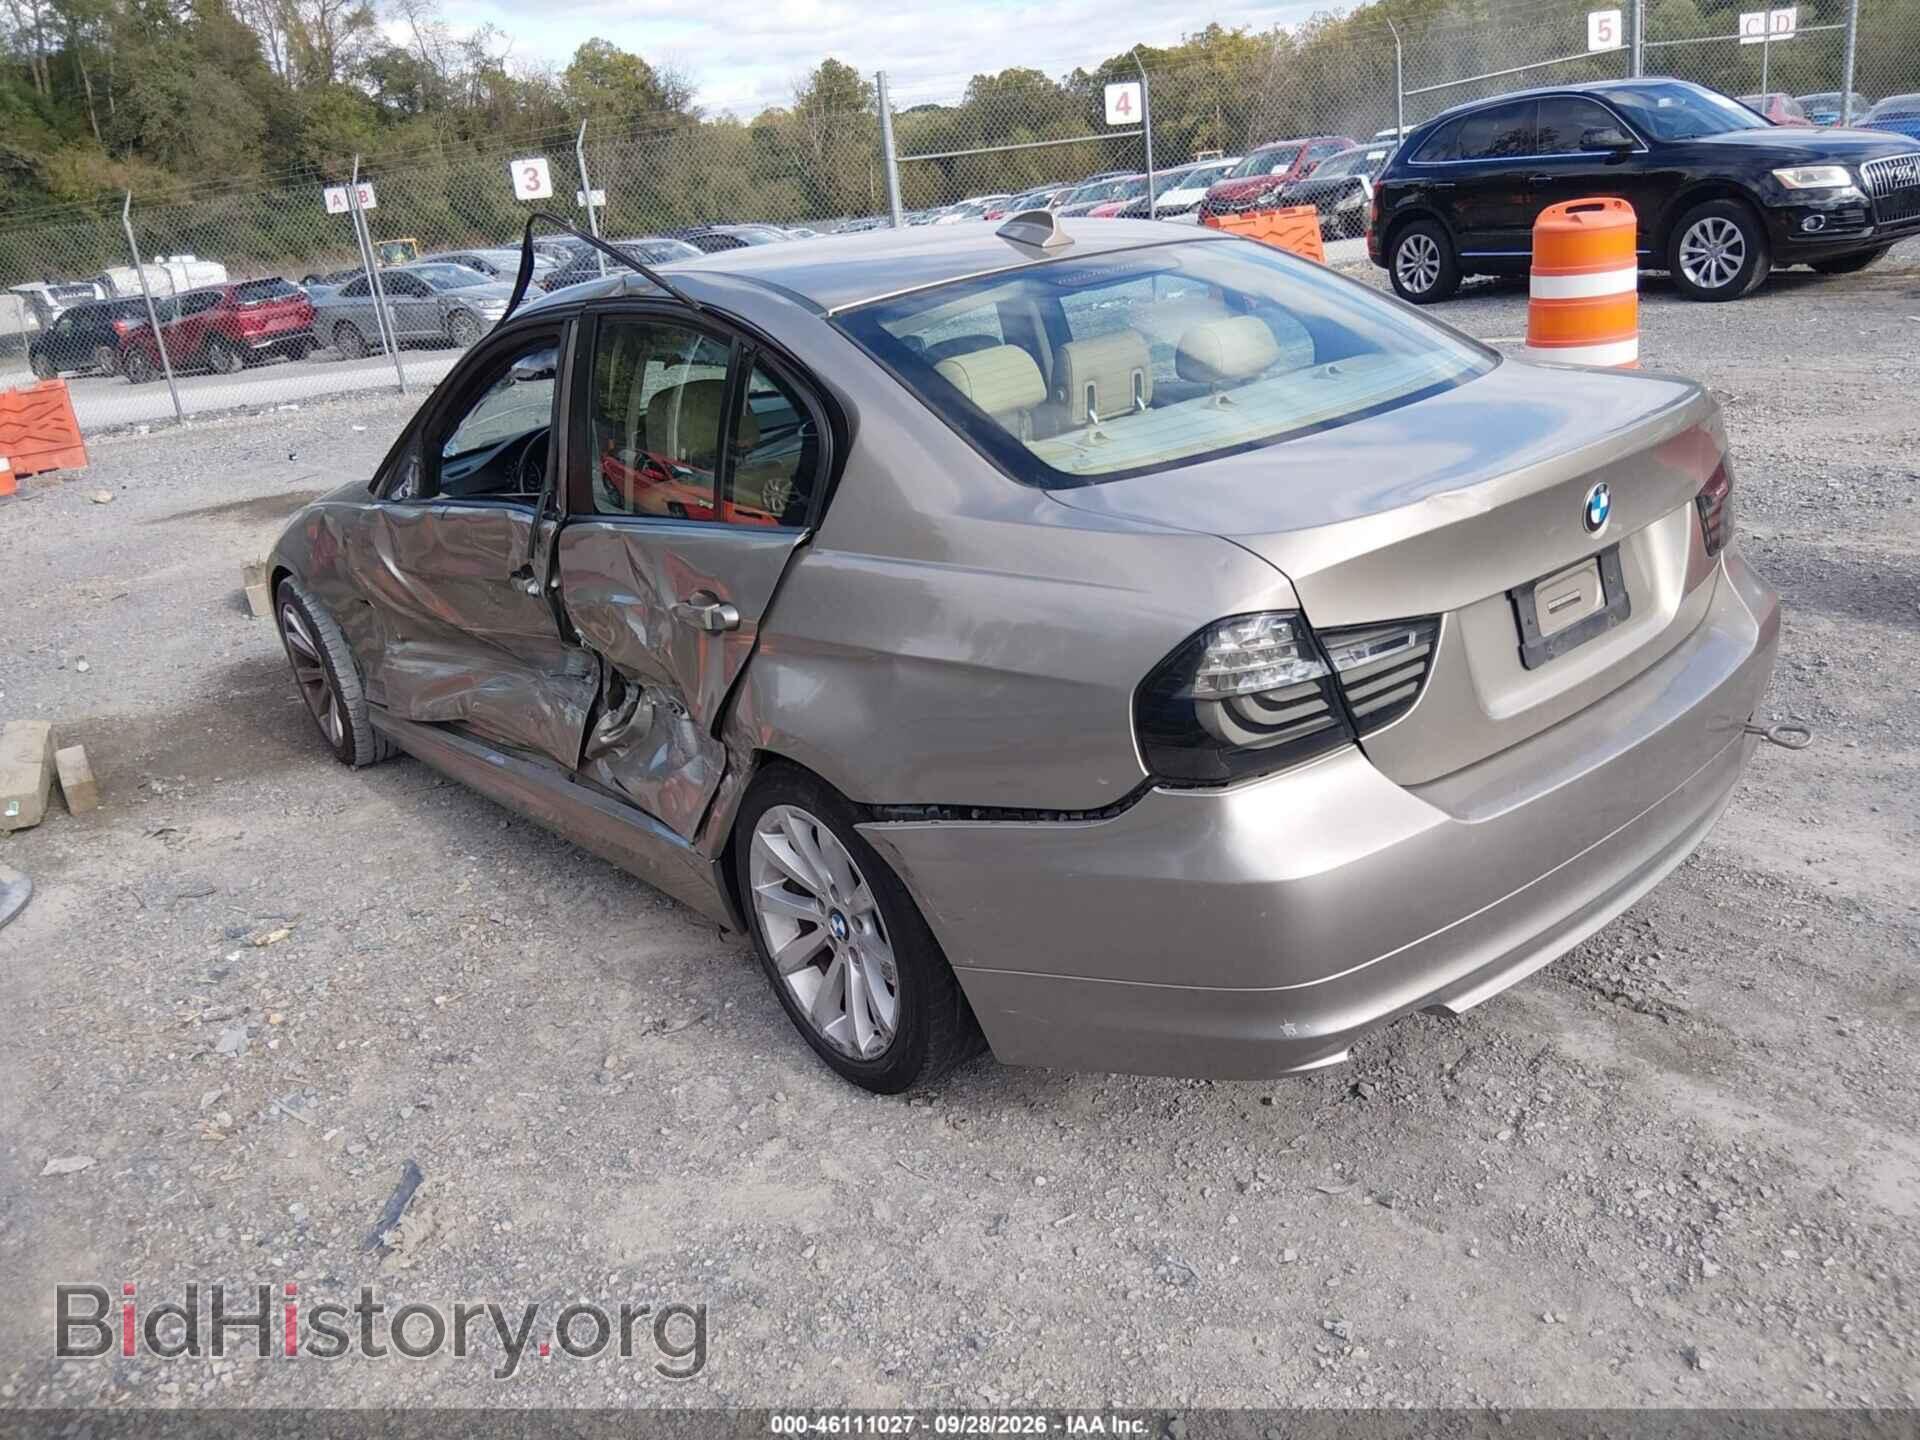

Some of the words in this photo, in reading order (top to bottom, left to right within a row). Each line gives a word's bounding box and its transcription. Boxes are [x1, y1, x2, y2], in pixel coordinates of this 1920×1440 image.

[1598, 17, 1612, 42] 5
[1745, 17, 1760, 36] C
[1776, 15, 1790, 33] D
[1115, 91, 1133, 116] 4
[522, 167, 541, 191] 3
[332, 194, 343, 208] A
[358, 190, 369, 204] B
